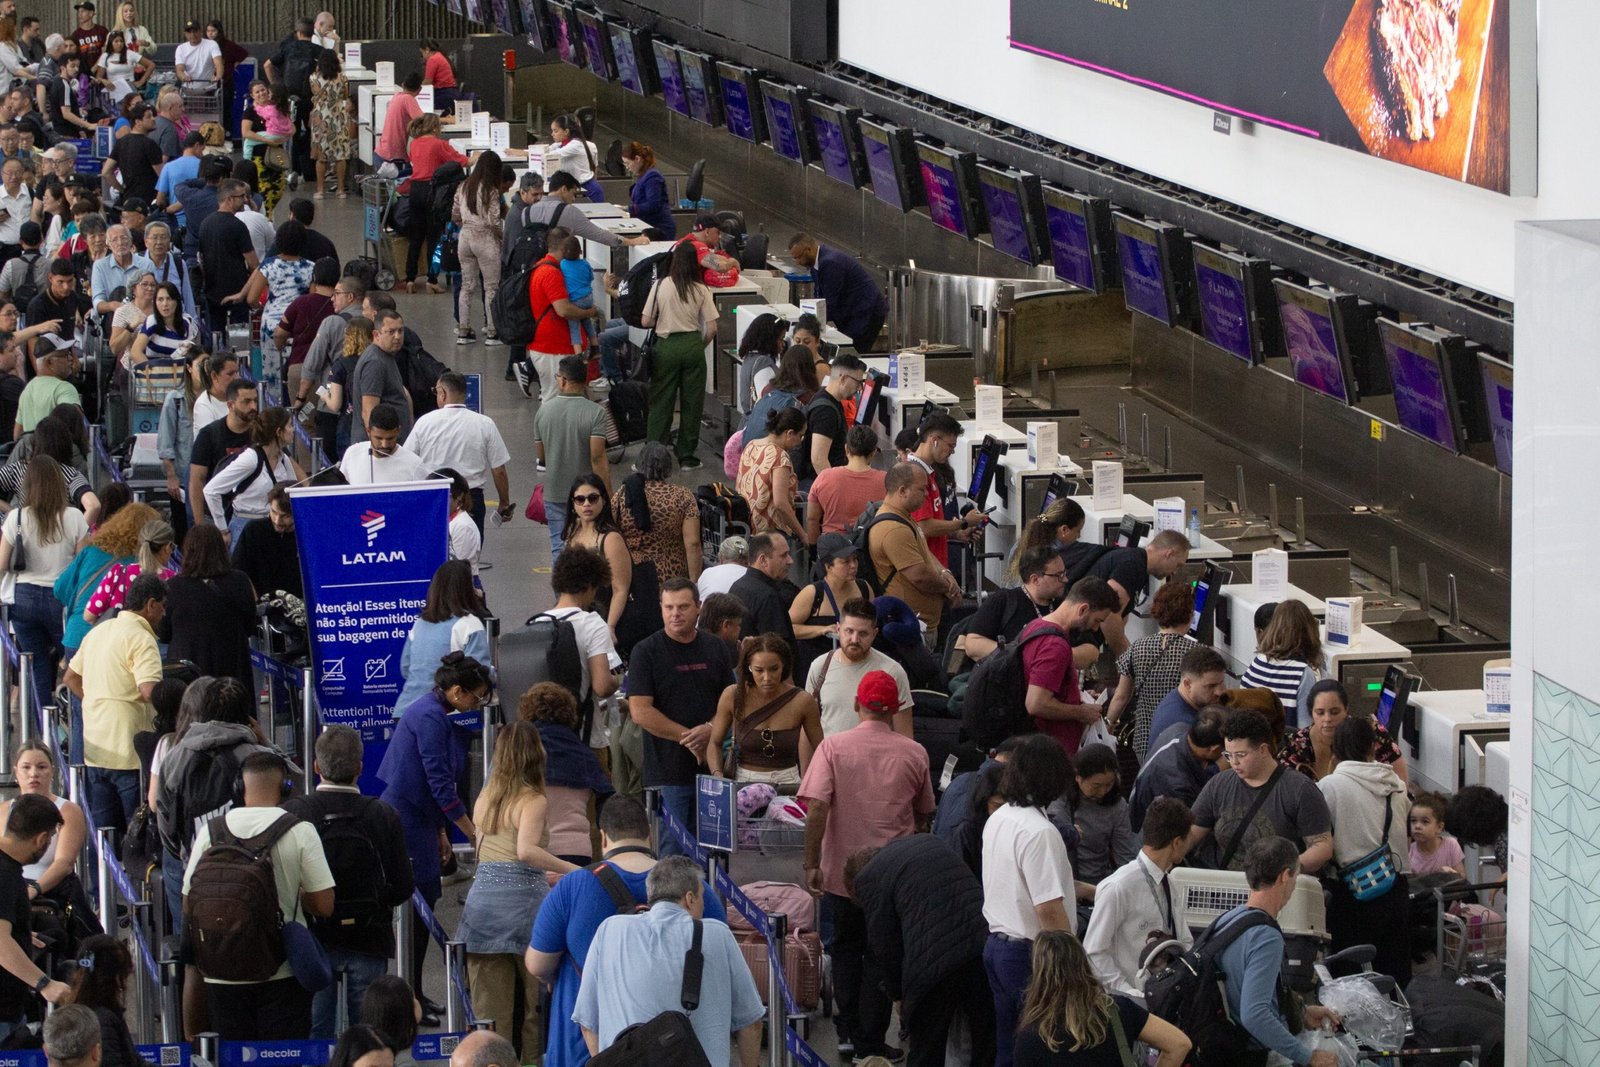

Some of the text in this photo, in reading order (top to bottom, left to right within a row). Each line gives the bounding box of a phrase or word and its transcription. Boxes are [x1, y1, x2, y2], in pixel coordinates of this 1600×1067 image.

[342, 551, 406, 565] LATAM
[315, 598, 427, 616] Atenção! Esses itens
[316, 612, 420, 630] não são permitidos
[317, 632, 336, 642] sua
[338, 630, 389, 645] bagagem
[391, 627, 406, 638] de
[322, 704, 395, 718] Attention! The
[361, 718, 394, 727] allowe
[260, 1048, 302, 1058] decolar
[0, 1058, 19, 1067] olar
